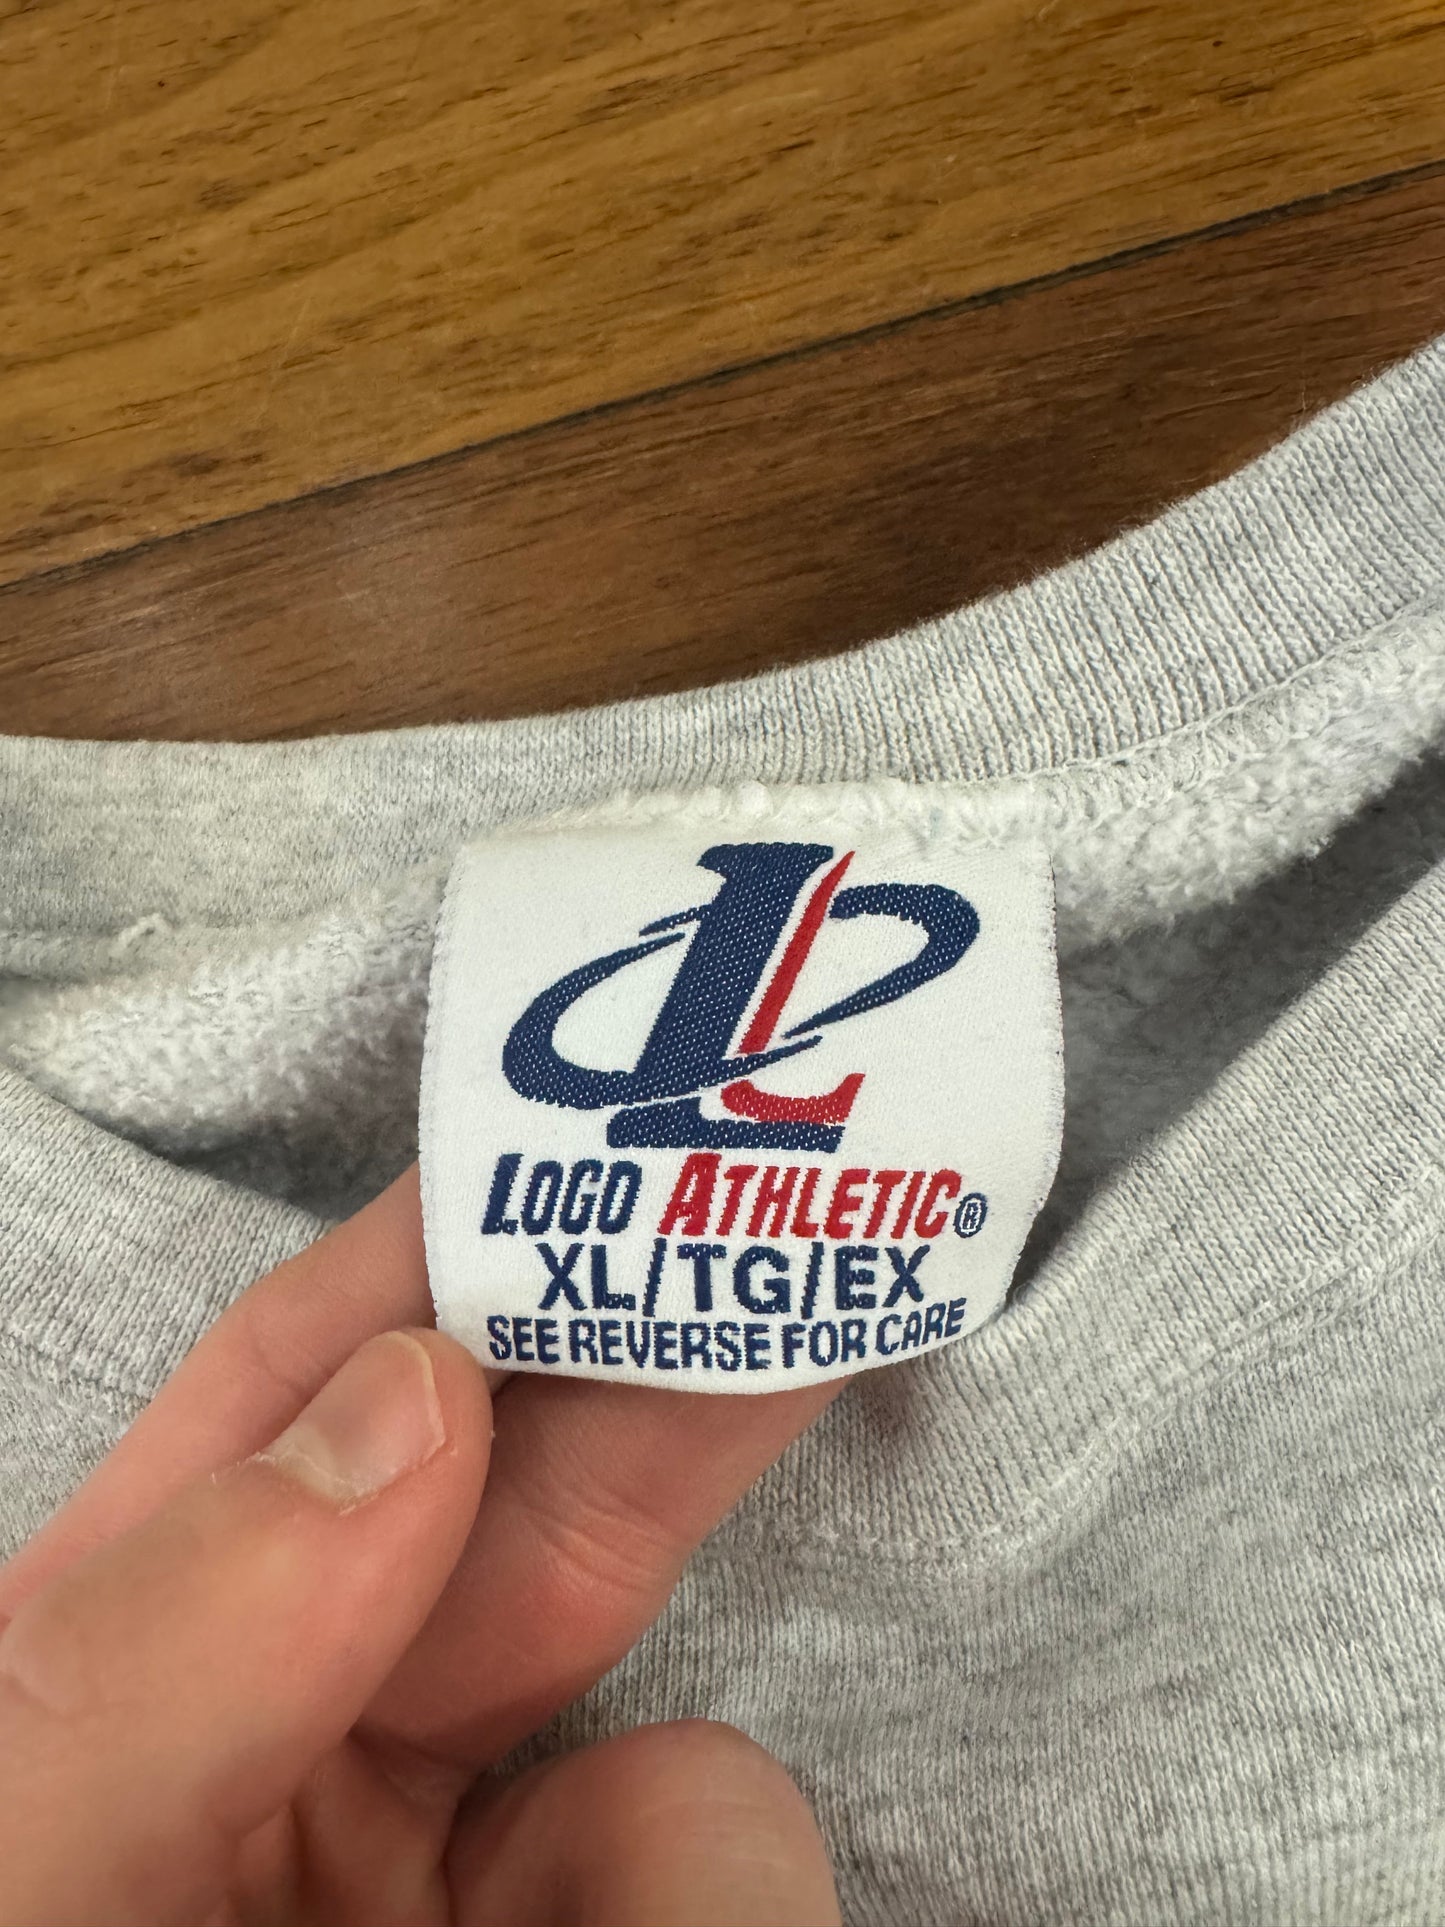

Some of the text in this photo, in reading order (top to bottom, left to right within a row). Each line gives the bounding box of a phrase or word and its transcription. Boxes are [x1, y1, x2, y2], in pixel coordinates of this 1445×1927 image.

[481, 1153, 643, 1235] LOGO
[535, 1238, 931, 1319] XL/TG/EX
[486, 1297, 967, 1371] SEE REVERSE FOR CARE
